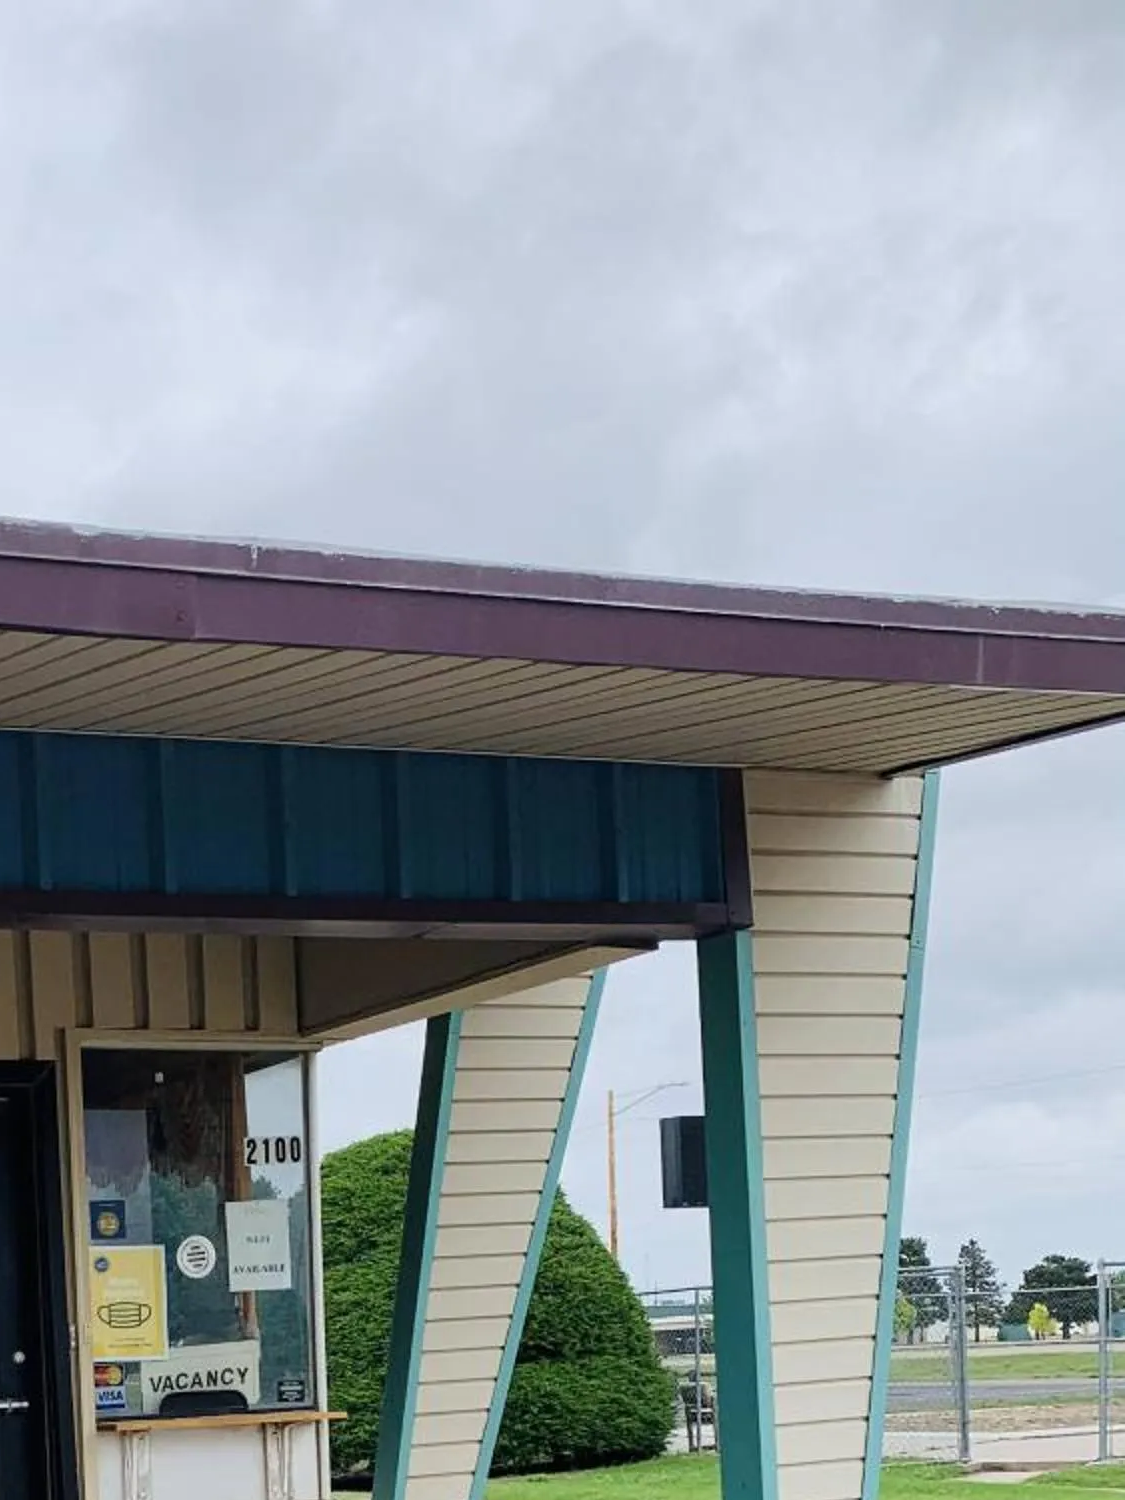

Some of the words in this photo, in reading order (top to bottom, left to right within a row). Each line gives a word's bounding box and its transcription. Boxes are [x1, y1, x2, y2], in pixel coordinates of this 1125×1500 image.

[246, 1136, 301, 1165] 2100
[233, 1263, 285, 1274] AVAILABLE
[149, 1368, 249, 1392] VACANCY
[98, 1390, 124, 1402] VISA
